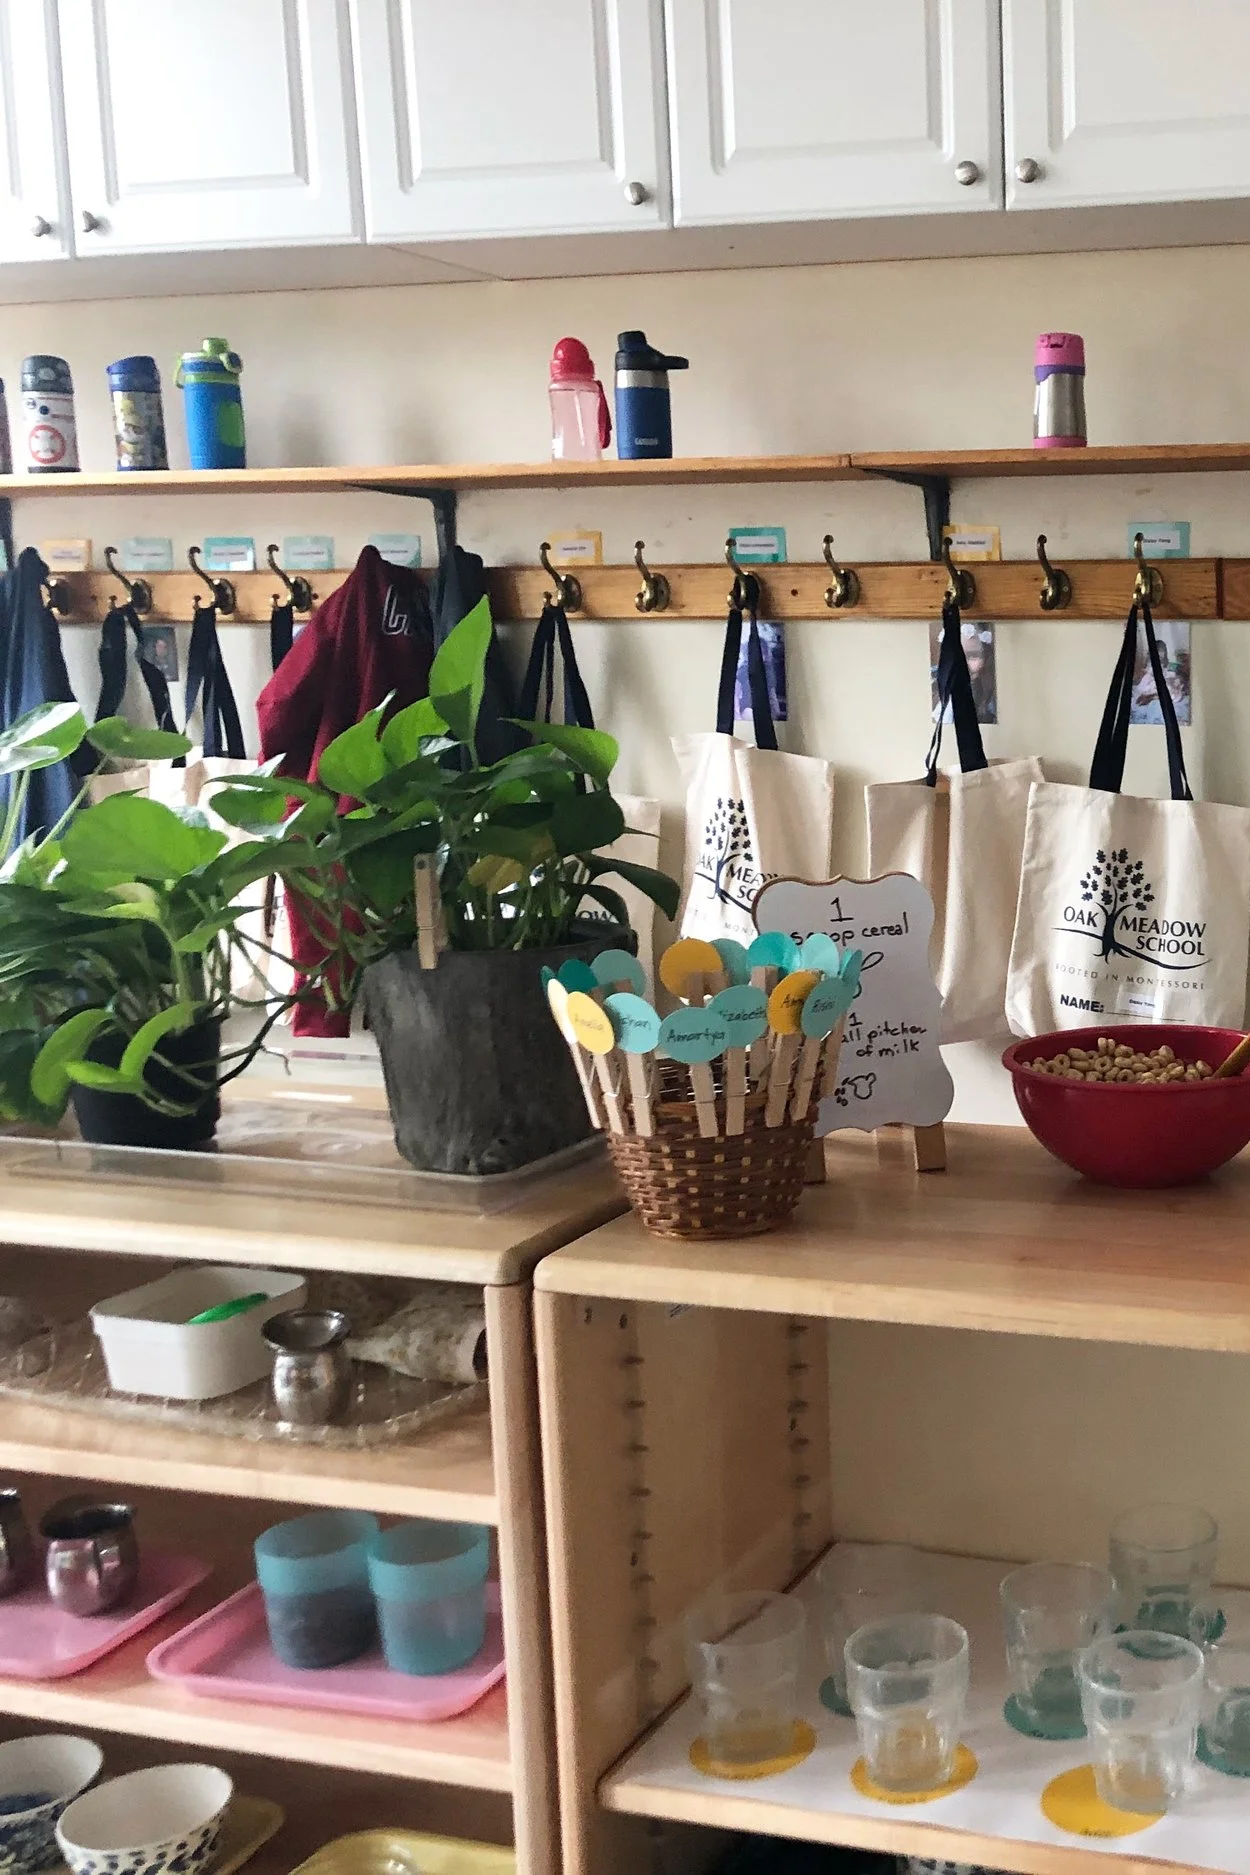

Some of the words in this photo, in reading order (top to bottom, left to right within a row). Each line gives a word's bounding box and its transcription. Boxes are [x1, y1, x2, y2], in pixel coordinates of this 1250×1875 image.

[696, 852, 715, 871] AK
[830, 897, 854, 922] 1
[790, 930, 855, 947] sop
[861, 911, 909, 938] cereal
[1063, 906, 1099, 928] OAK
[1119, 915, 1207, 939] MEADOW
[1135, 935, 1206, 956] SCHOOL
[1105, 973, 1118, 982] IN
[1126, 975, 1205, 990] MONESSORI
[1060, 994, 1105, 1013] NAME:
[848, 1012, 863, 1026] 1
[867, 1020, 928, 1043] pitcher
[855, 1046, 873, 1058] of
[878, 1038, 920, 1058] milk
